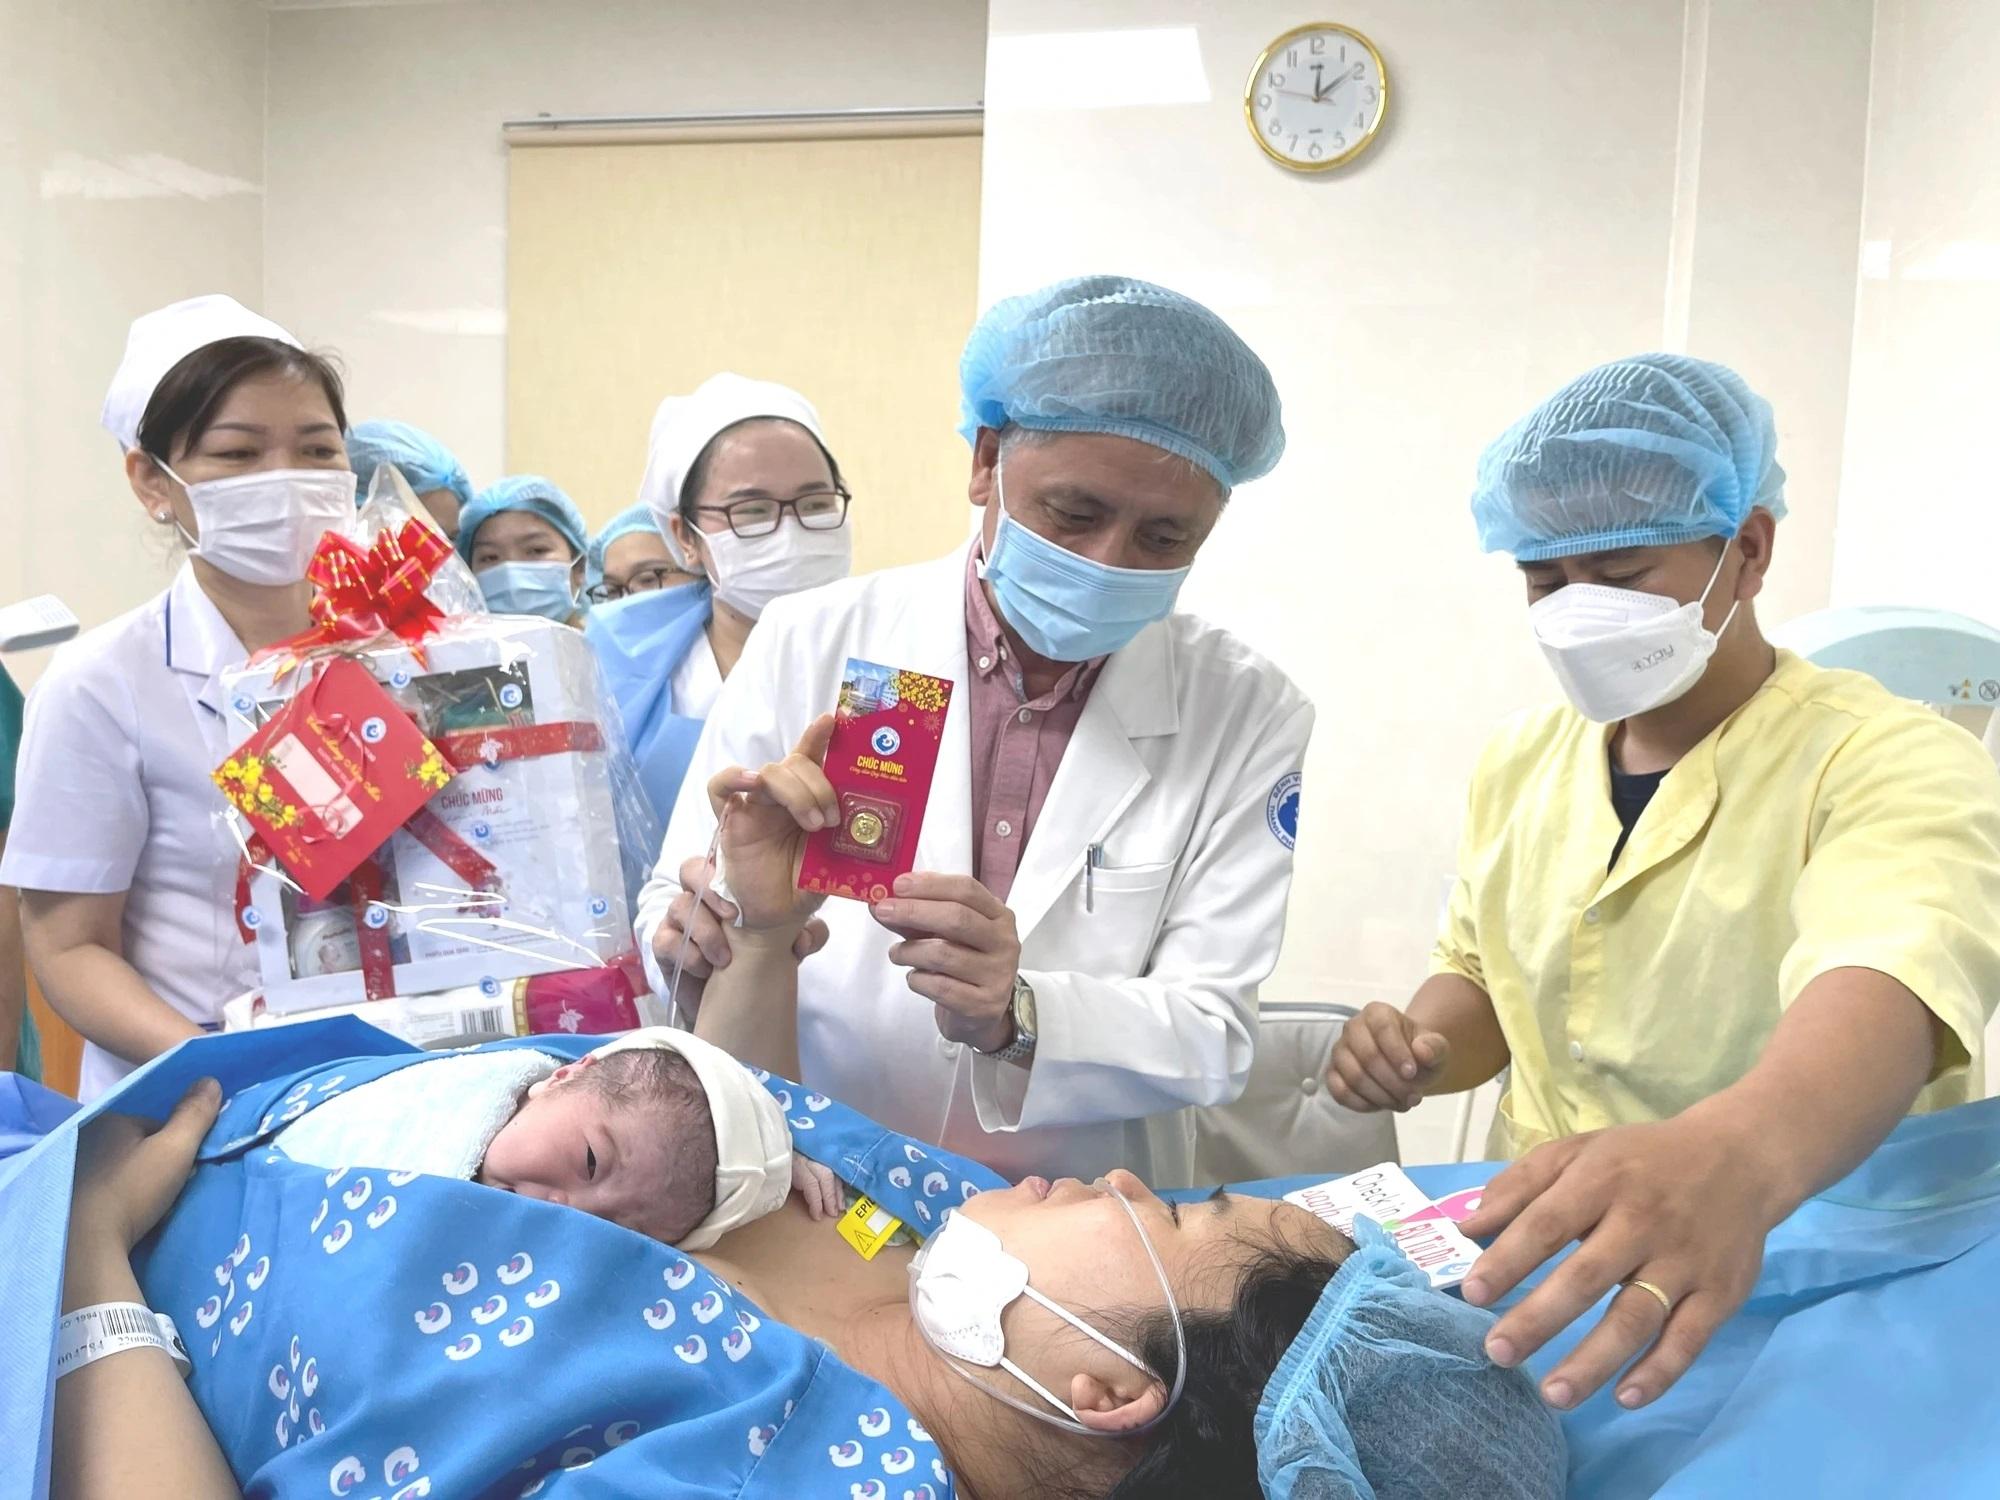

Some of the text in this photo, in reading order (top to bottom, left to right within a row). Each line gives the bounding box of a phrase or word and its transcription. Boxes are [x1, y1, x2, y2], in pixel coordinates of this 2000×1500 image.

[1310, 36, 1325, 55] 12
[1340, 45, 1346, 63] 1
[1286, 50, 1297, 68] 11
[1268, 72, 1285, 88] 10
[1352, 62, 1365, 80] 2
[1258, 94, 1272, 112] 9
[1363, 85, 1376, 104] 3
[1268, 118, 1282, 136] 8
[1354, 112, 1364, 129] 4
[1288, 134, 1299, 152] 7
[1333, 131, 1346, 149] 5
[1308, 142, 1323, 160] 6
[857, 755, 879, 770] CHÚC
[440, 791, 470, 809] CHÚC
[1352, 1173, 1401, 1208] Check
[1394, 1223, 1438, 1242] BV
